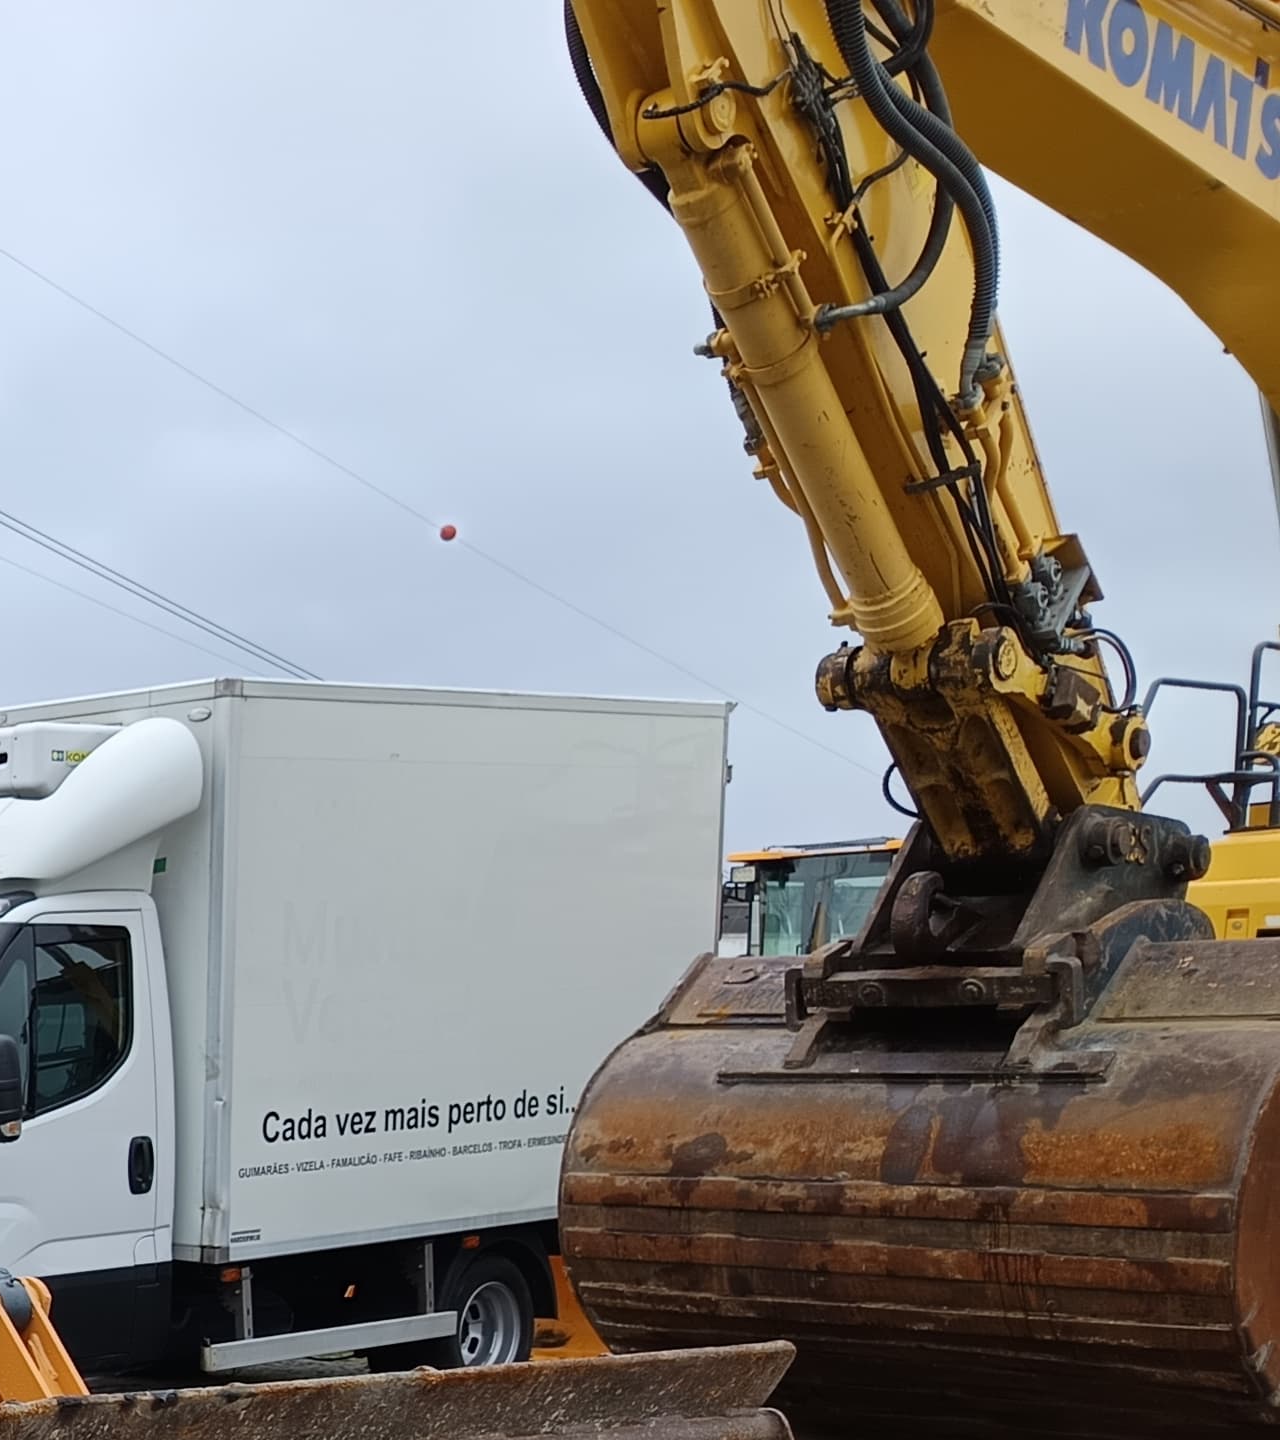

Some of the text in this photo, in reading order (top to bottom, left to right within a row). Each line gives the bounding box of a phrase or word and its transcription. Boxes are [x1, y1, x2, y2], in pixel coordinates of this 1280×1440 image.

[262, 1108, 327, 1143] Cada
[335, 1111, 377, 1136] vez
[384, 1099, 440, 1132] mais
[448, 1094, 506, 1133] perto
[514, 1089, 539, 1118] de
[296, 1160, 325, 1173] VIZELA
[384, 1151, 403, 1163] FAFE
[452, 1142, 493, 1156] BARCELOS
[499, 1139, 522, 1151] TROFA
